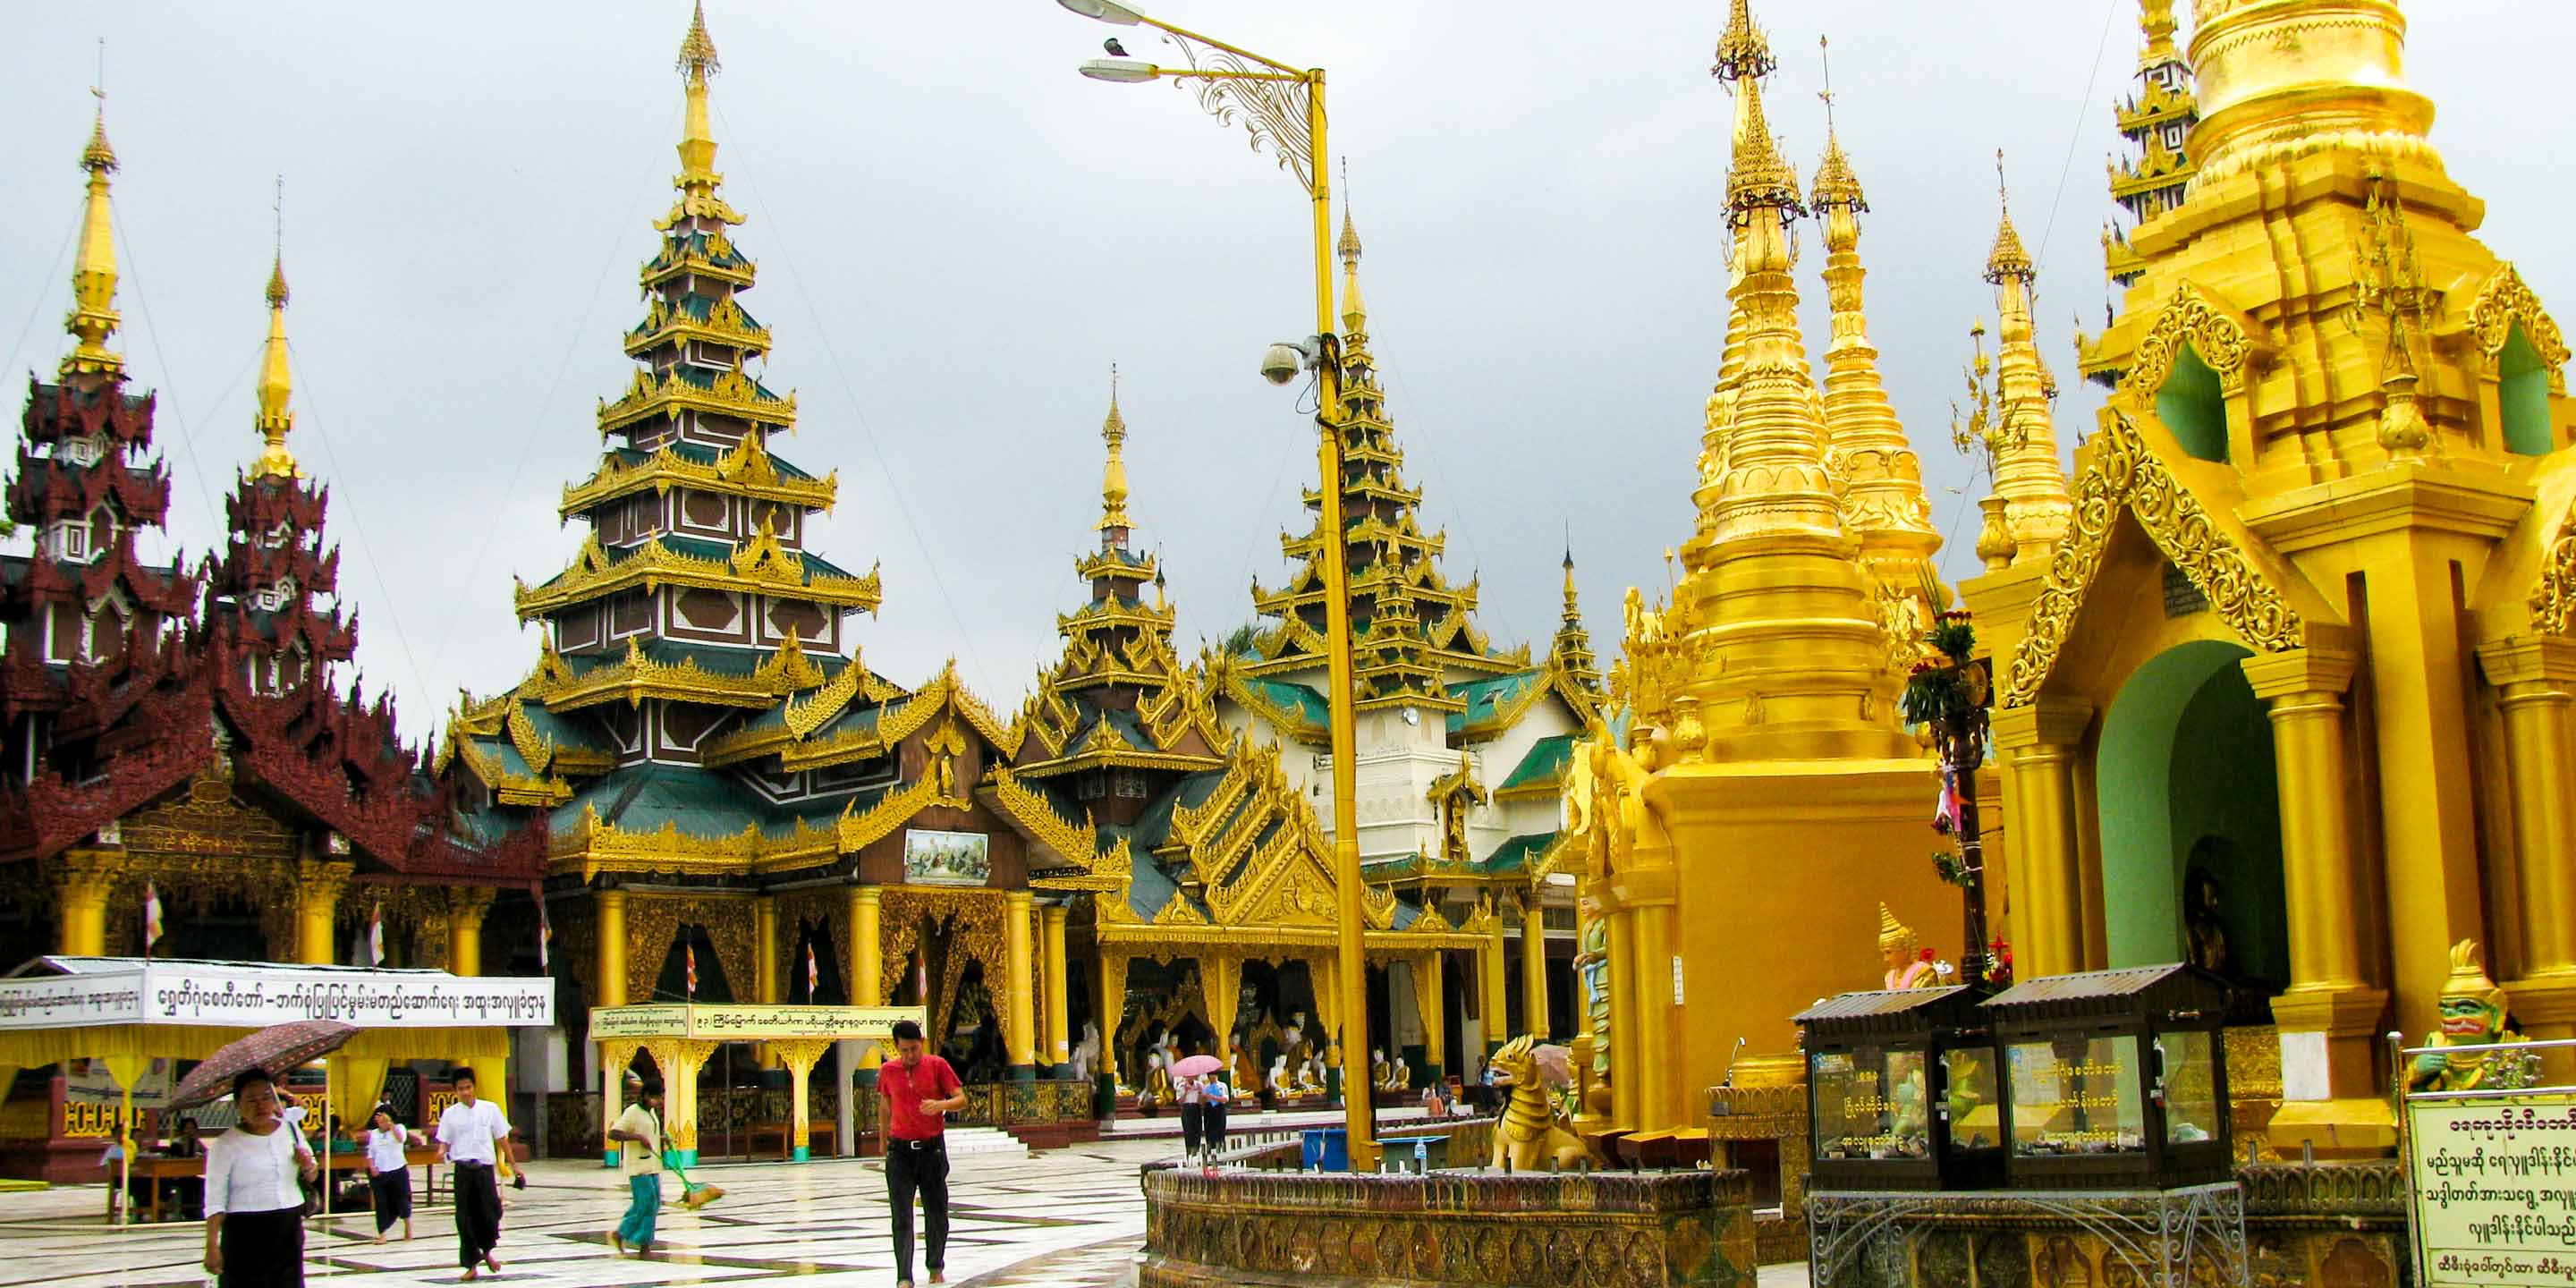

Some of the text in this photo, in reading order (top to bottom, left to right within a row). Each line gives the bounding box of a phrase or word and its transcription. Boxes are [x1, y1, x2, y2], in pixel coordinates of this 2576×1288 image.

[2488, 1146, 2576, 1176] ရေလှူဒါန်းနိုင်
